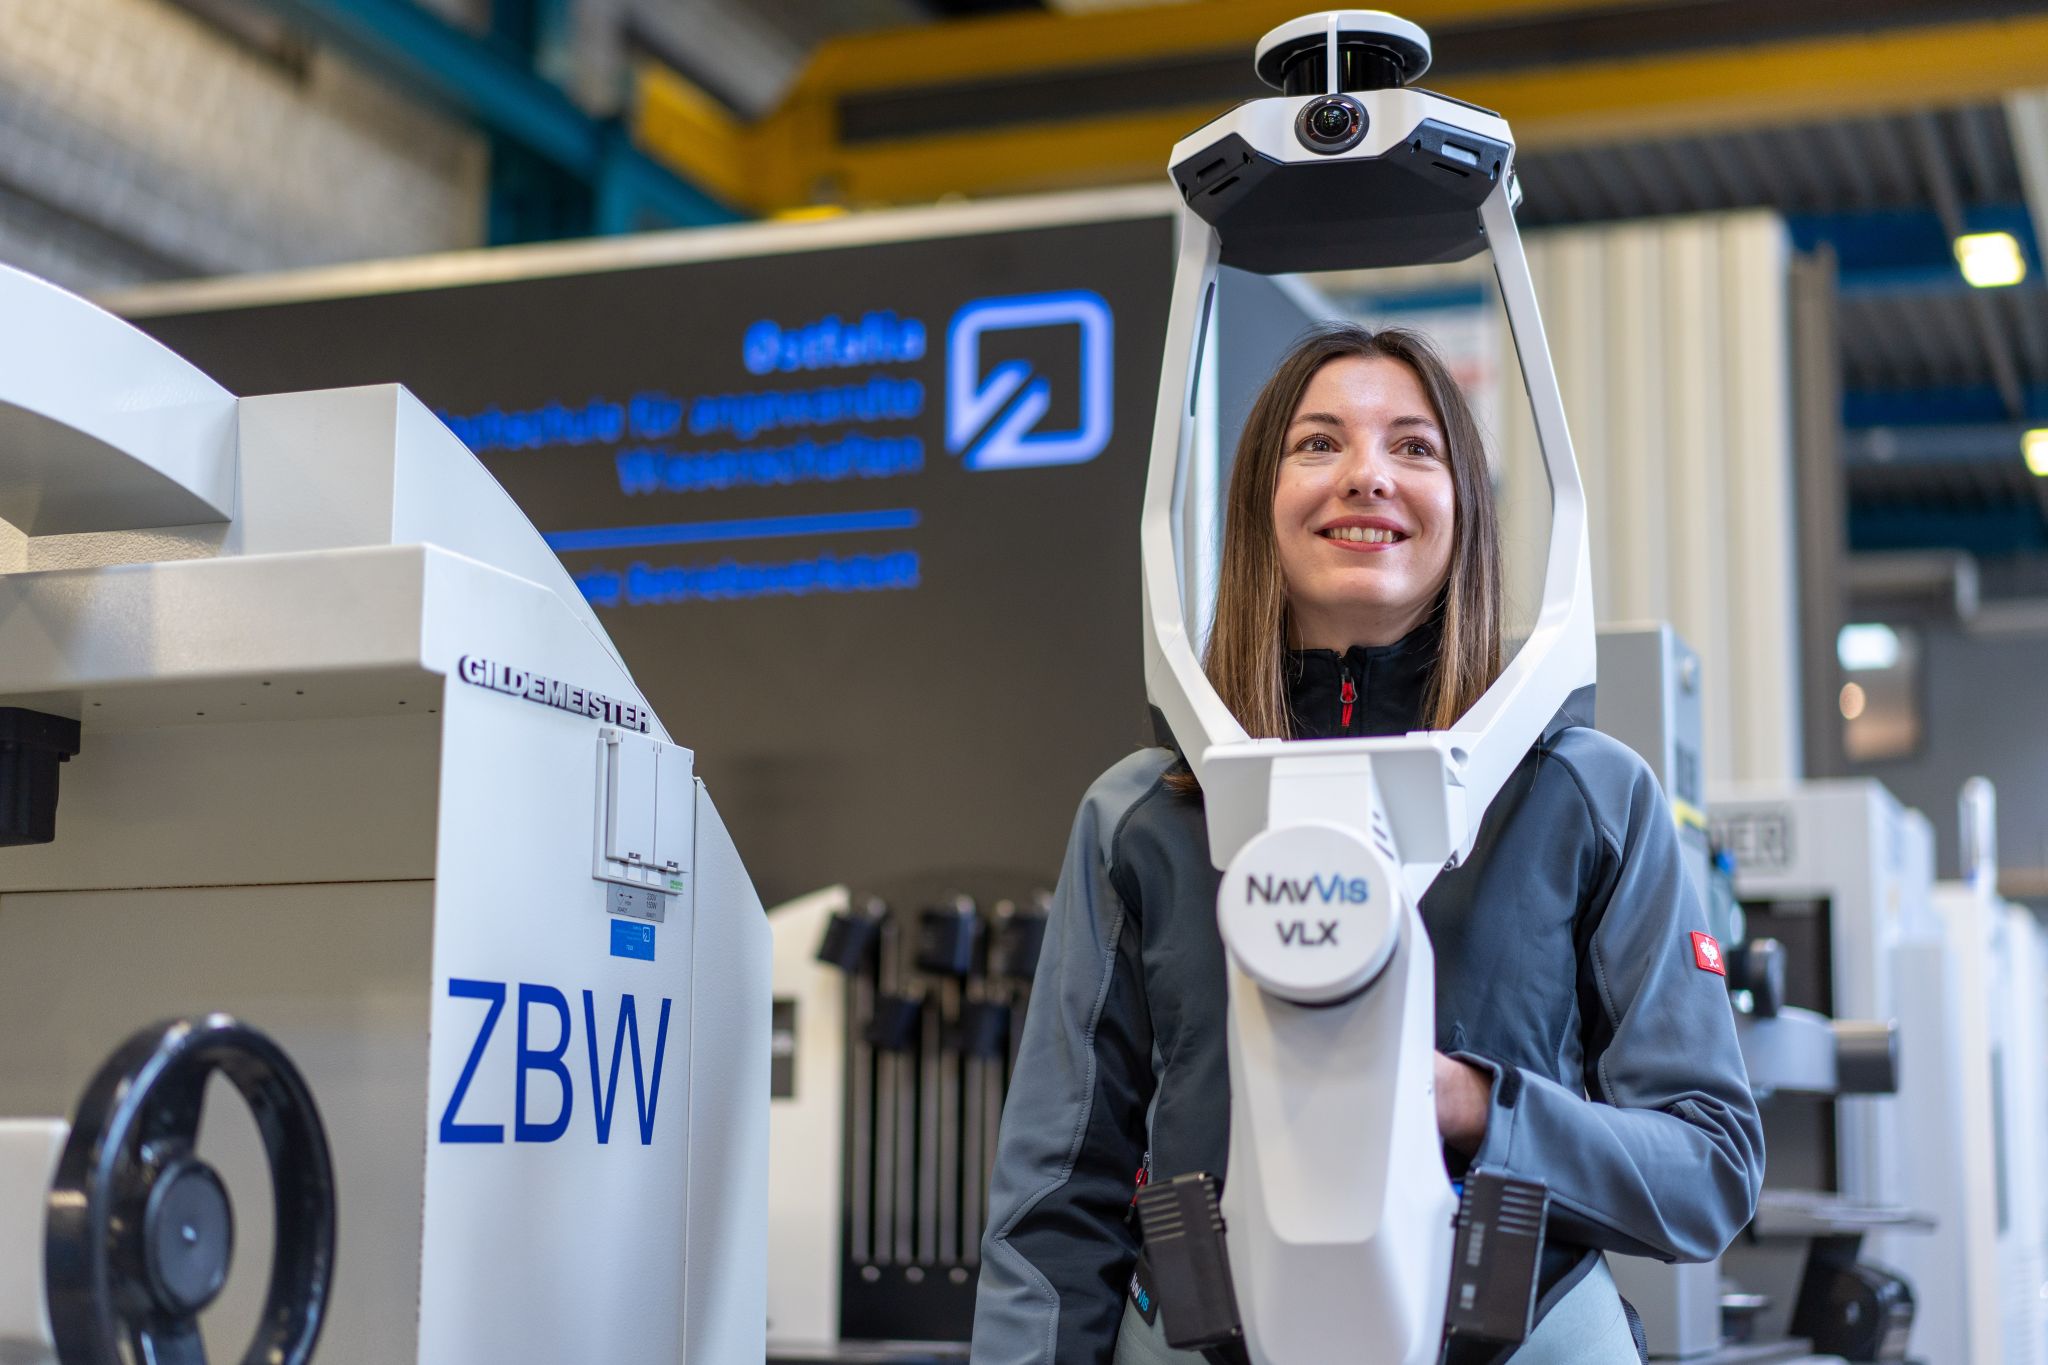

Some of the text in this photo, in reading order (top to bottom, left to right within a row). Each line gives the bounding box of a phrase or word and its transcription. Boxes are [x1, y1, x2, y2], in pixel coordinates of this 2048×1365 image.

[459, 655, 650, 733] GILDEMEISTER
[1276, 920, 1338, 946] VLX
[439, 977, 672, 1146] ZBW
